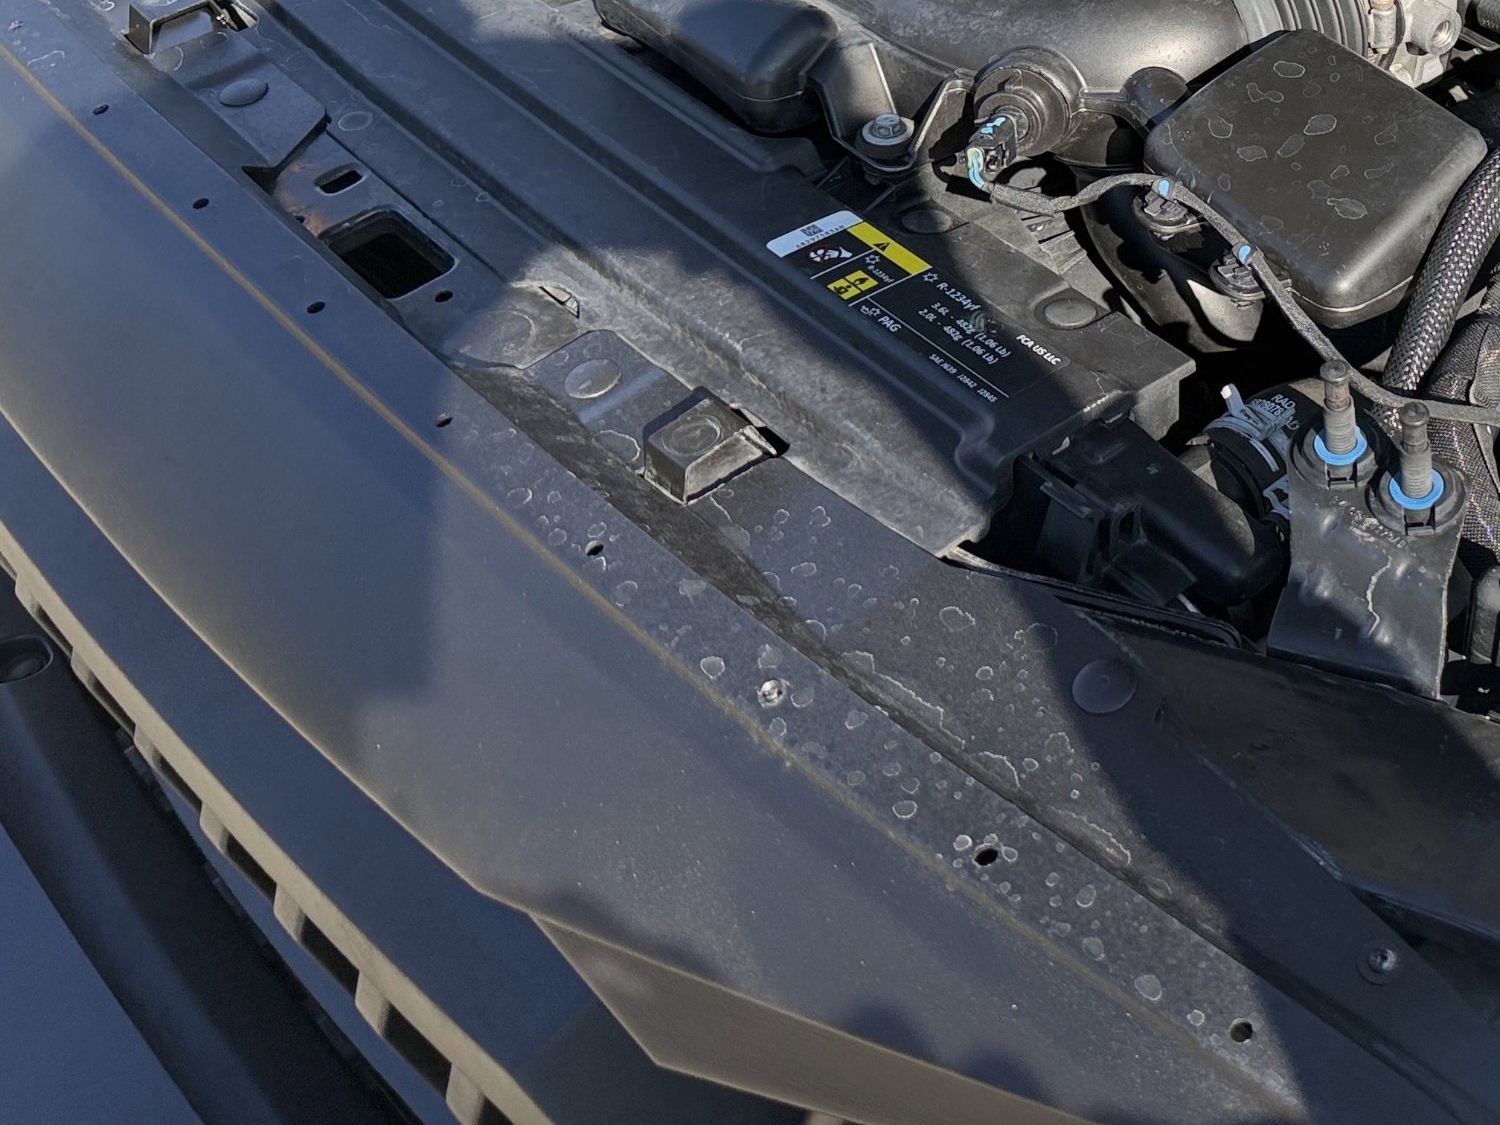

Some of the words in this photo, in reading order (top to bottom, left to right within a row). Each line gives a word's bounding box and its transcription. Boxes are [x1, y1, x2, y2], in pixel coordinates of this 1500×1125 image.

[936, 282, 981, 311] R-1234yf
[878, 315, 901, 332] PAG
[918, 308, 937, 322] 2.0L
[961, 339, 985, 355] (1.06
[931, 302, 950, 316] 3.6L
[974, 332, 998, 349] (1.06
[929, 353, 944, 365] SAE
[1016, 334, 1034, 348] FCA
[1032, 344, 1047, 357] US
[1043, 352, 1061, 365] LLC
[1271, 394, 1295, 409] RAD
